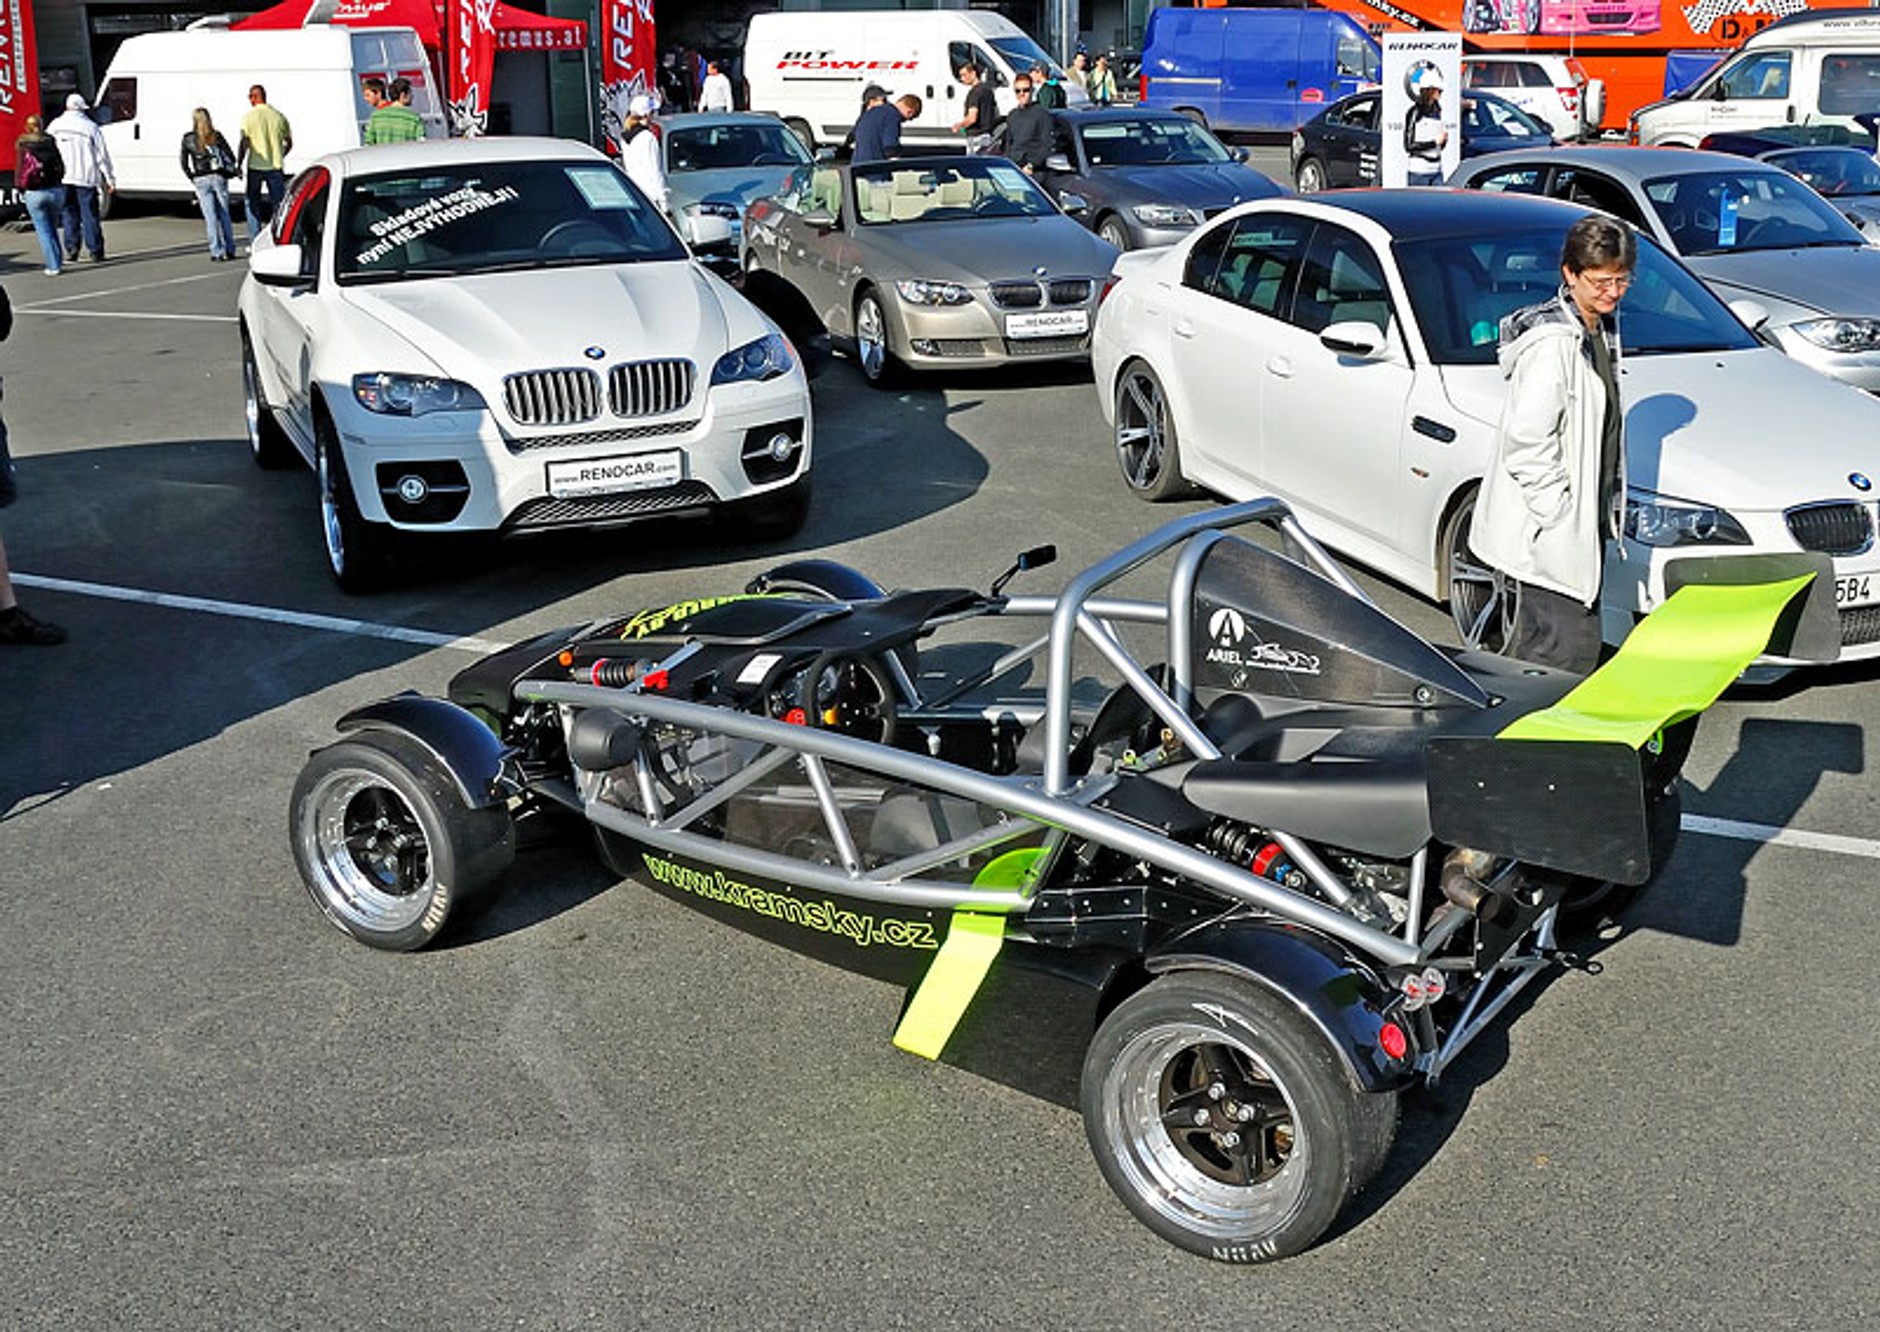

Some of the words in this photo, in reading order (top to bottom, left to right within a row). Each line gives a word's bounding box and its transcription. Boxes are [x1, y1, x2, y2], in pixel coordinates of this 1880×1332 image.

[499, 26, 582, 48] remus.at
[783, 50, 834, 60] BIT
[776, 61, 919, 69] POWER
[1206, 648, 1243, 664] ARIEL
[642, 853, 938, 949] www.kramsky.cz
